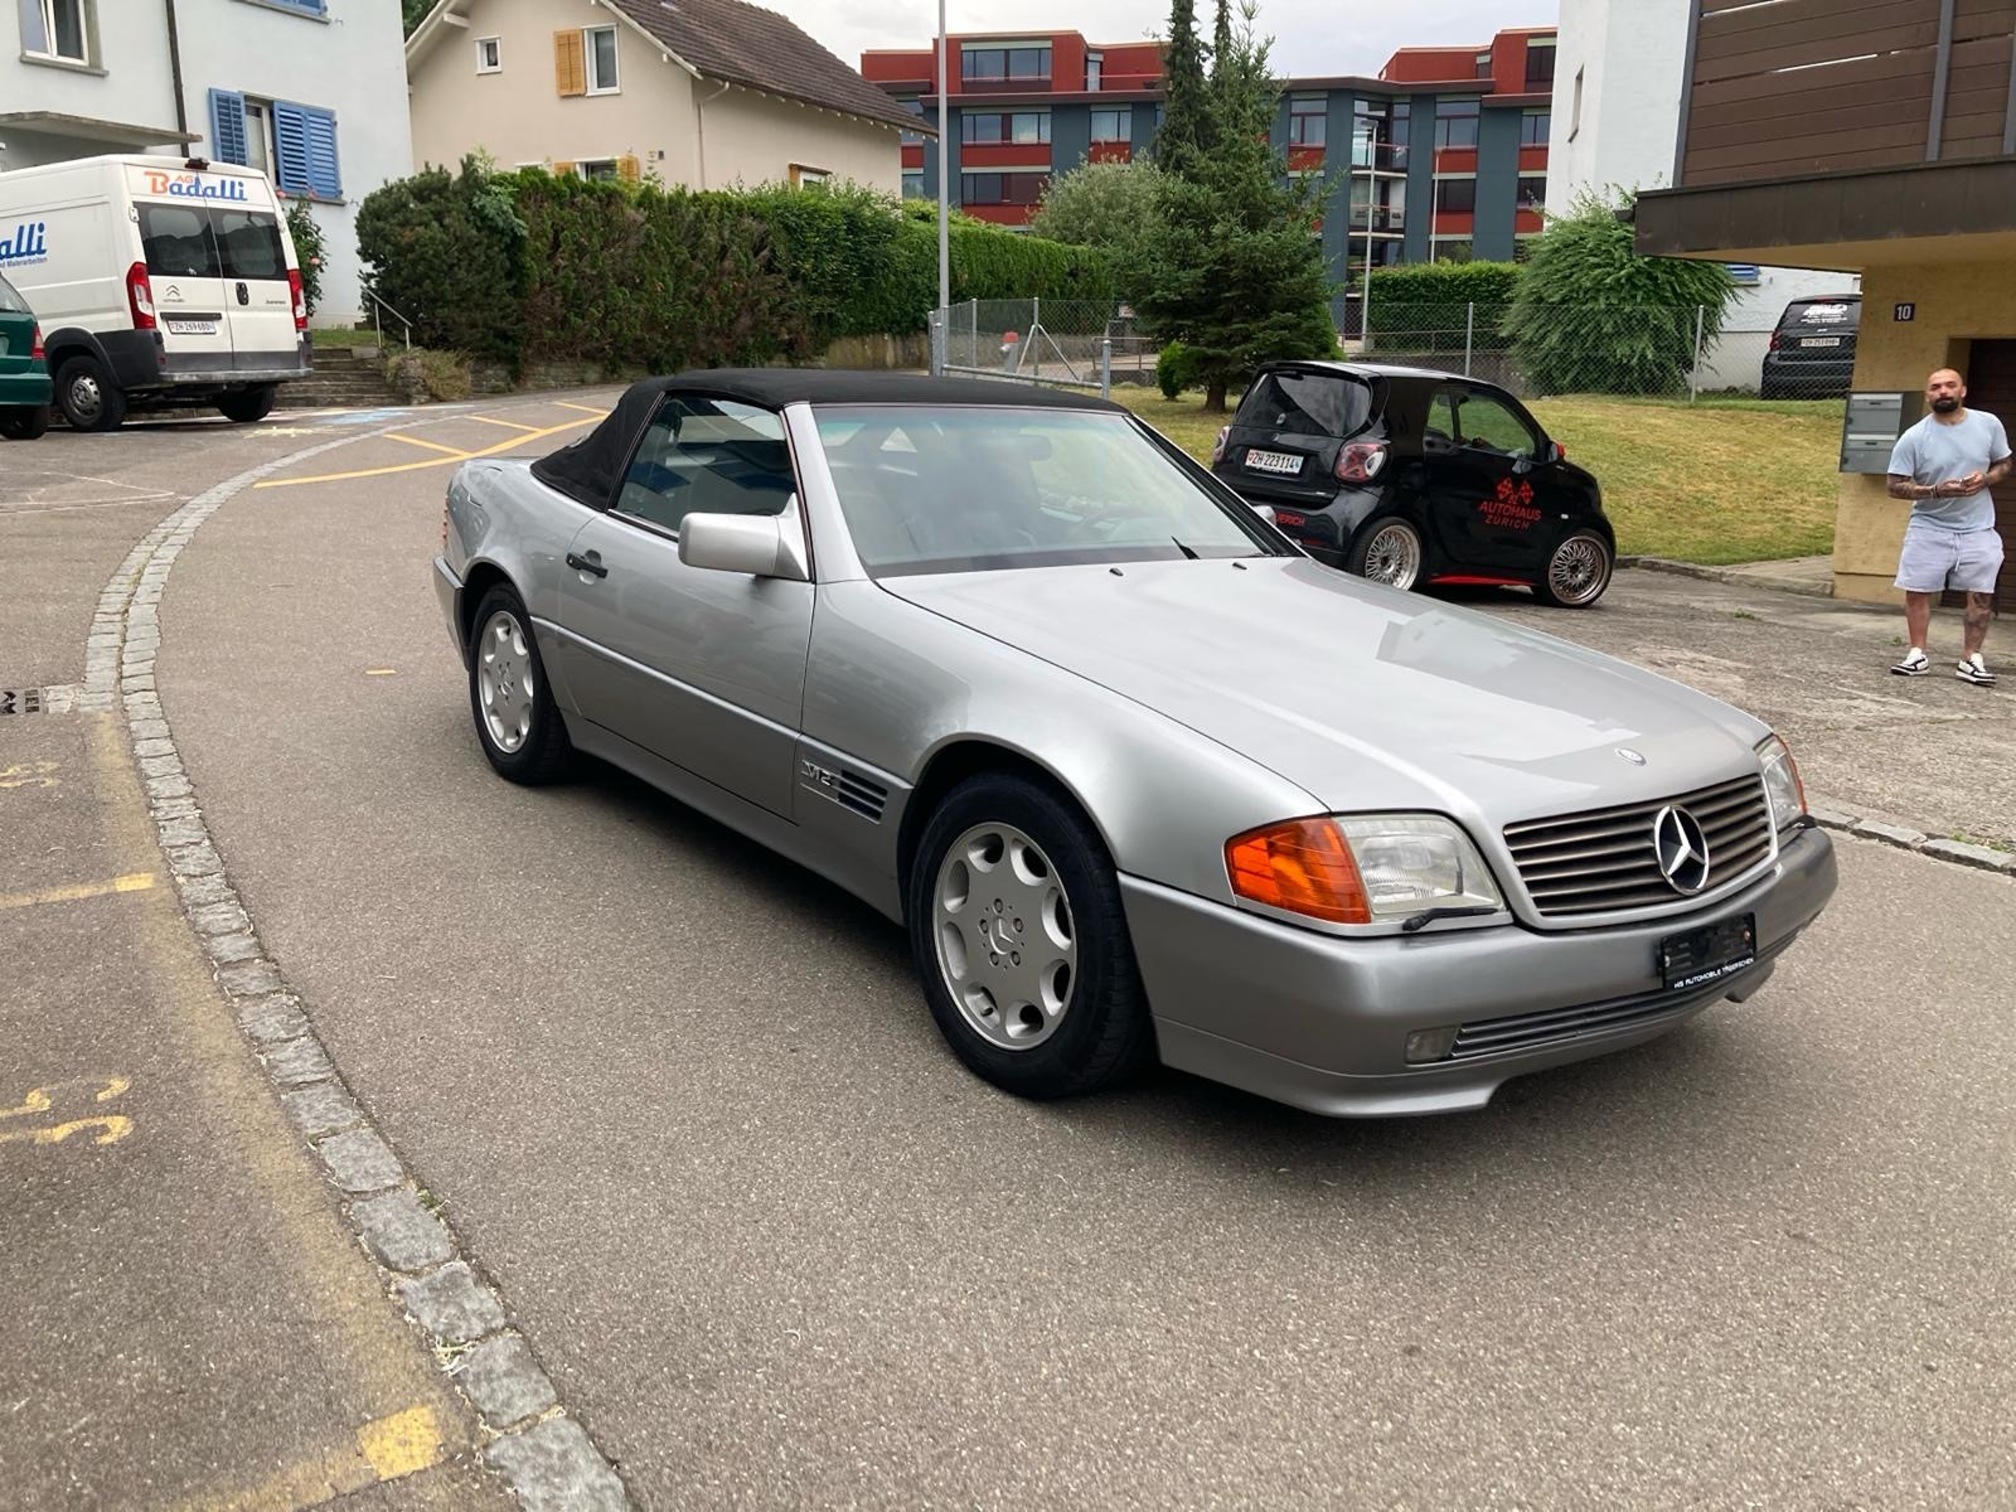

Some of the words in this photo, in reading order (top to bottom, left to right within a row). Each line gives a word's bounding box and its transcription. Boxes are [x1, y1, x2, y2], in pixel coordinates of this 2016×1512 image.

[144, 171, 248, 201] Badalli
[1896, 305, 1912, 320] 10
[1478, 500, 1542, 521] AUTOHAUS
[1685, 968, 1722, 986] AUTOMOBILE
